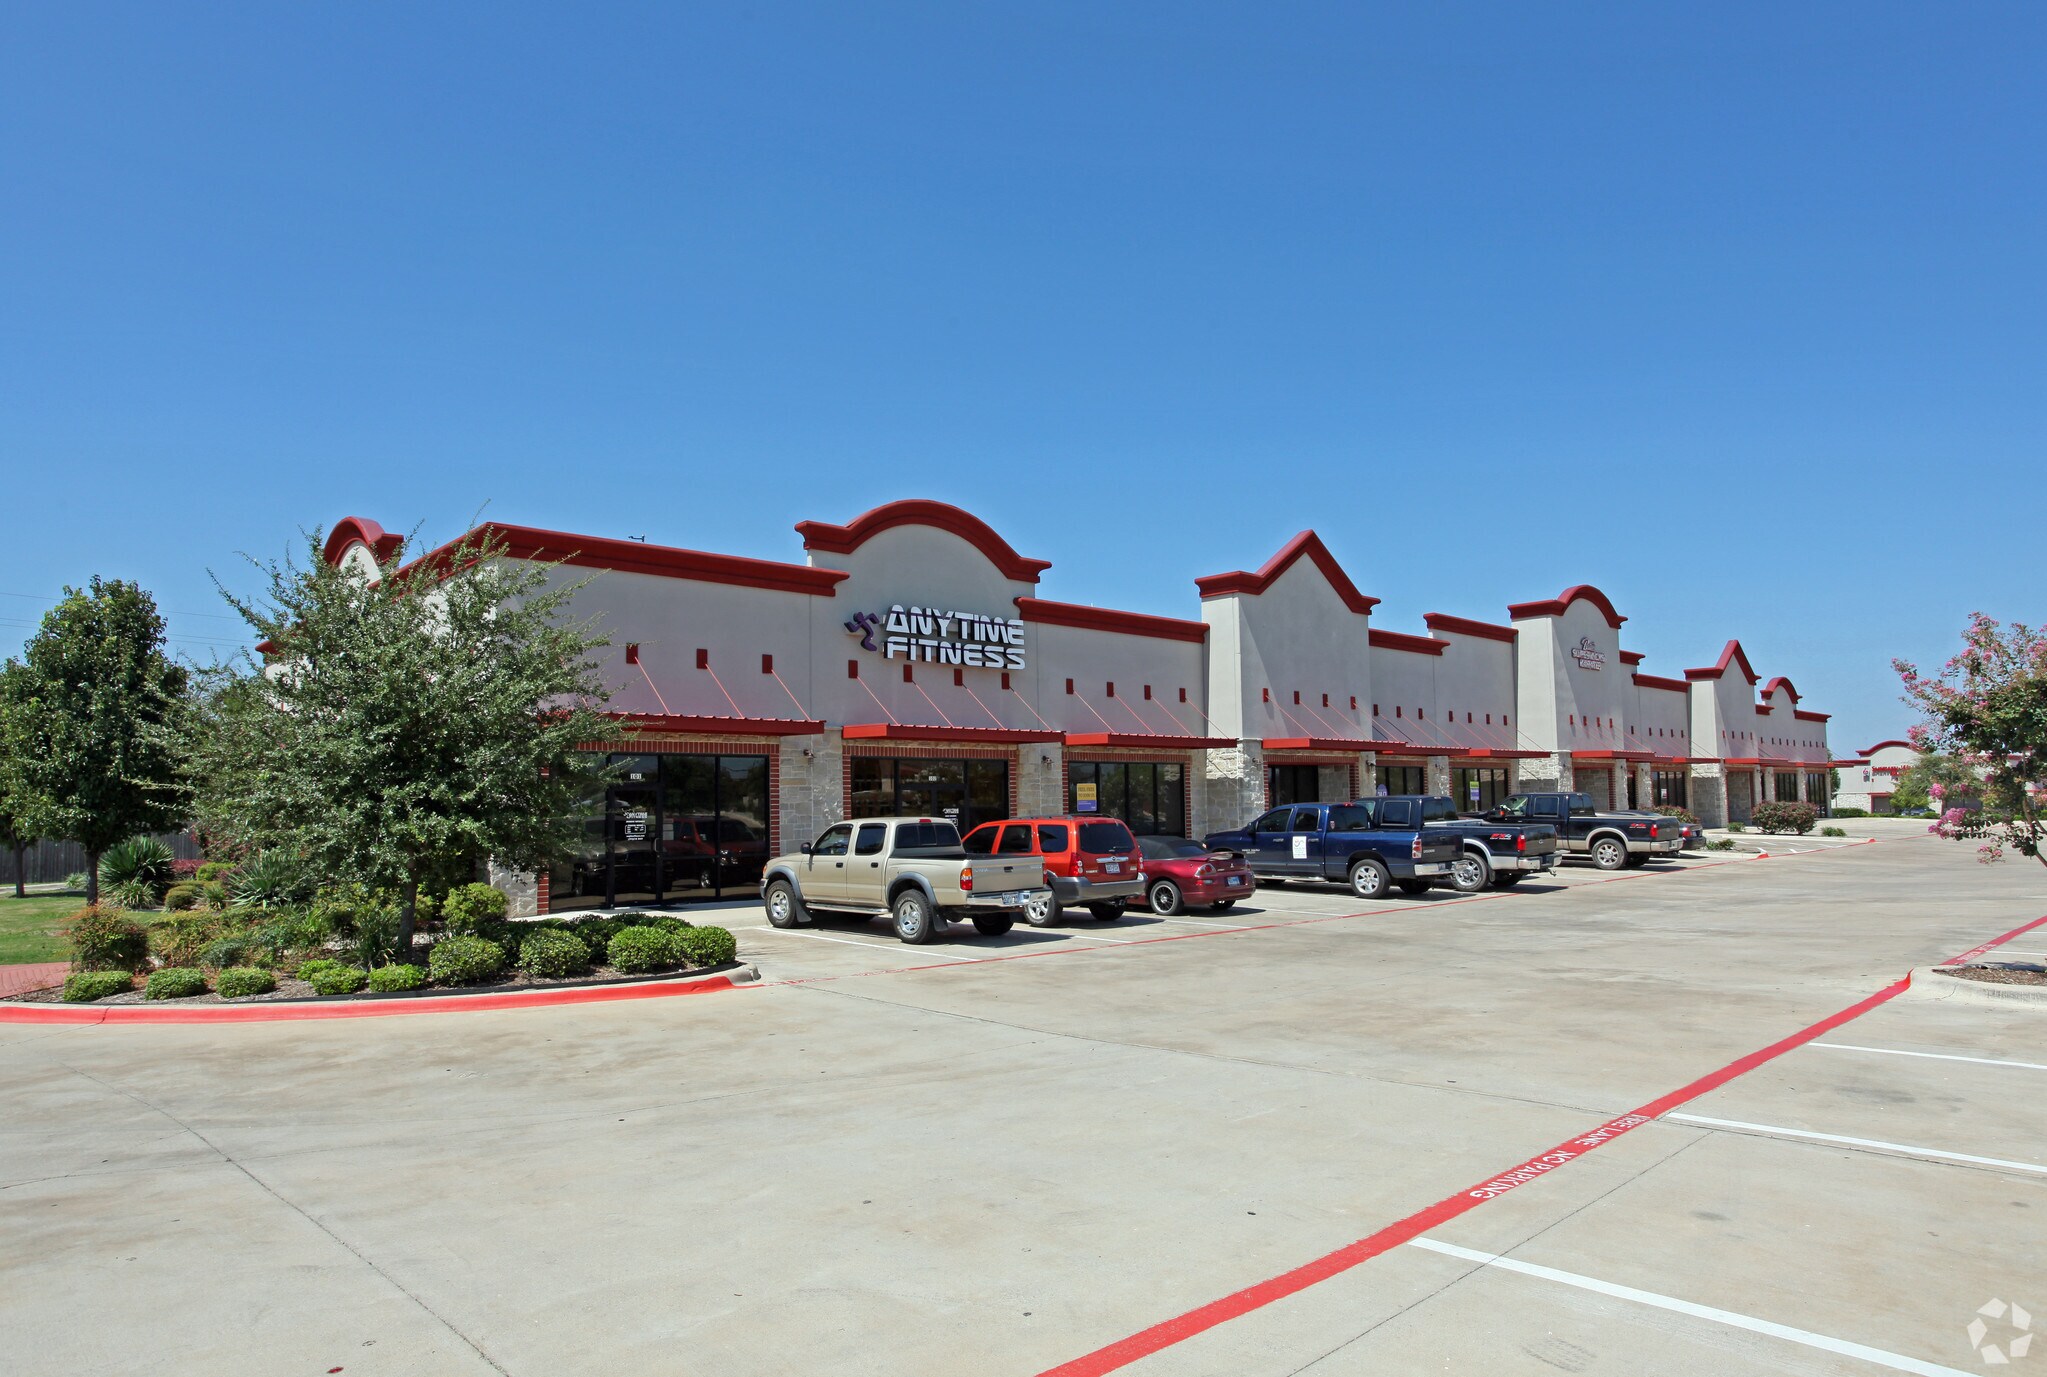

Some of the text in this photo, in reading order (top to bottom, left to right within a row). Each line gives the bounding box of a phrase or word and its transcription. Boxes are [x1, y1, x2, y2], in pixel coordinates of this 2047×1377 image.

[886, 604, 1025, 645] ANYTIME
[885, 636, 1026, 670] FITNESS
[1574, 1127, 1623, 1147] LANE
[1469, 1162, 1555, 1199] PARKING
